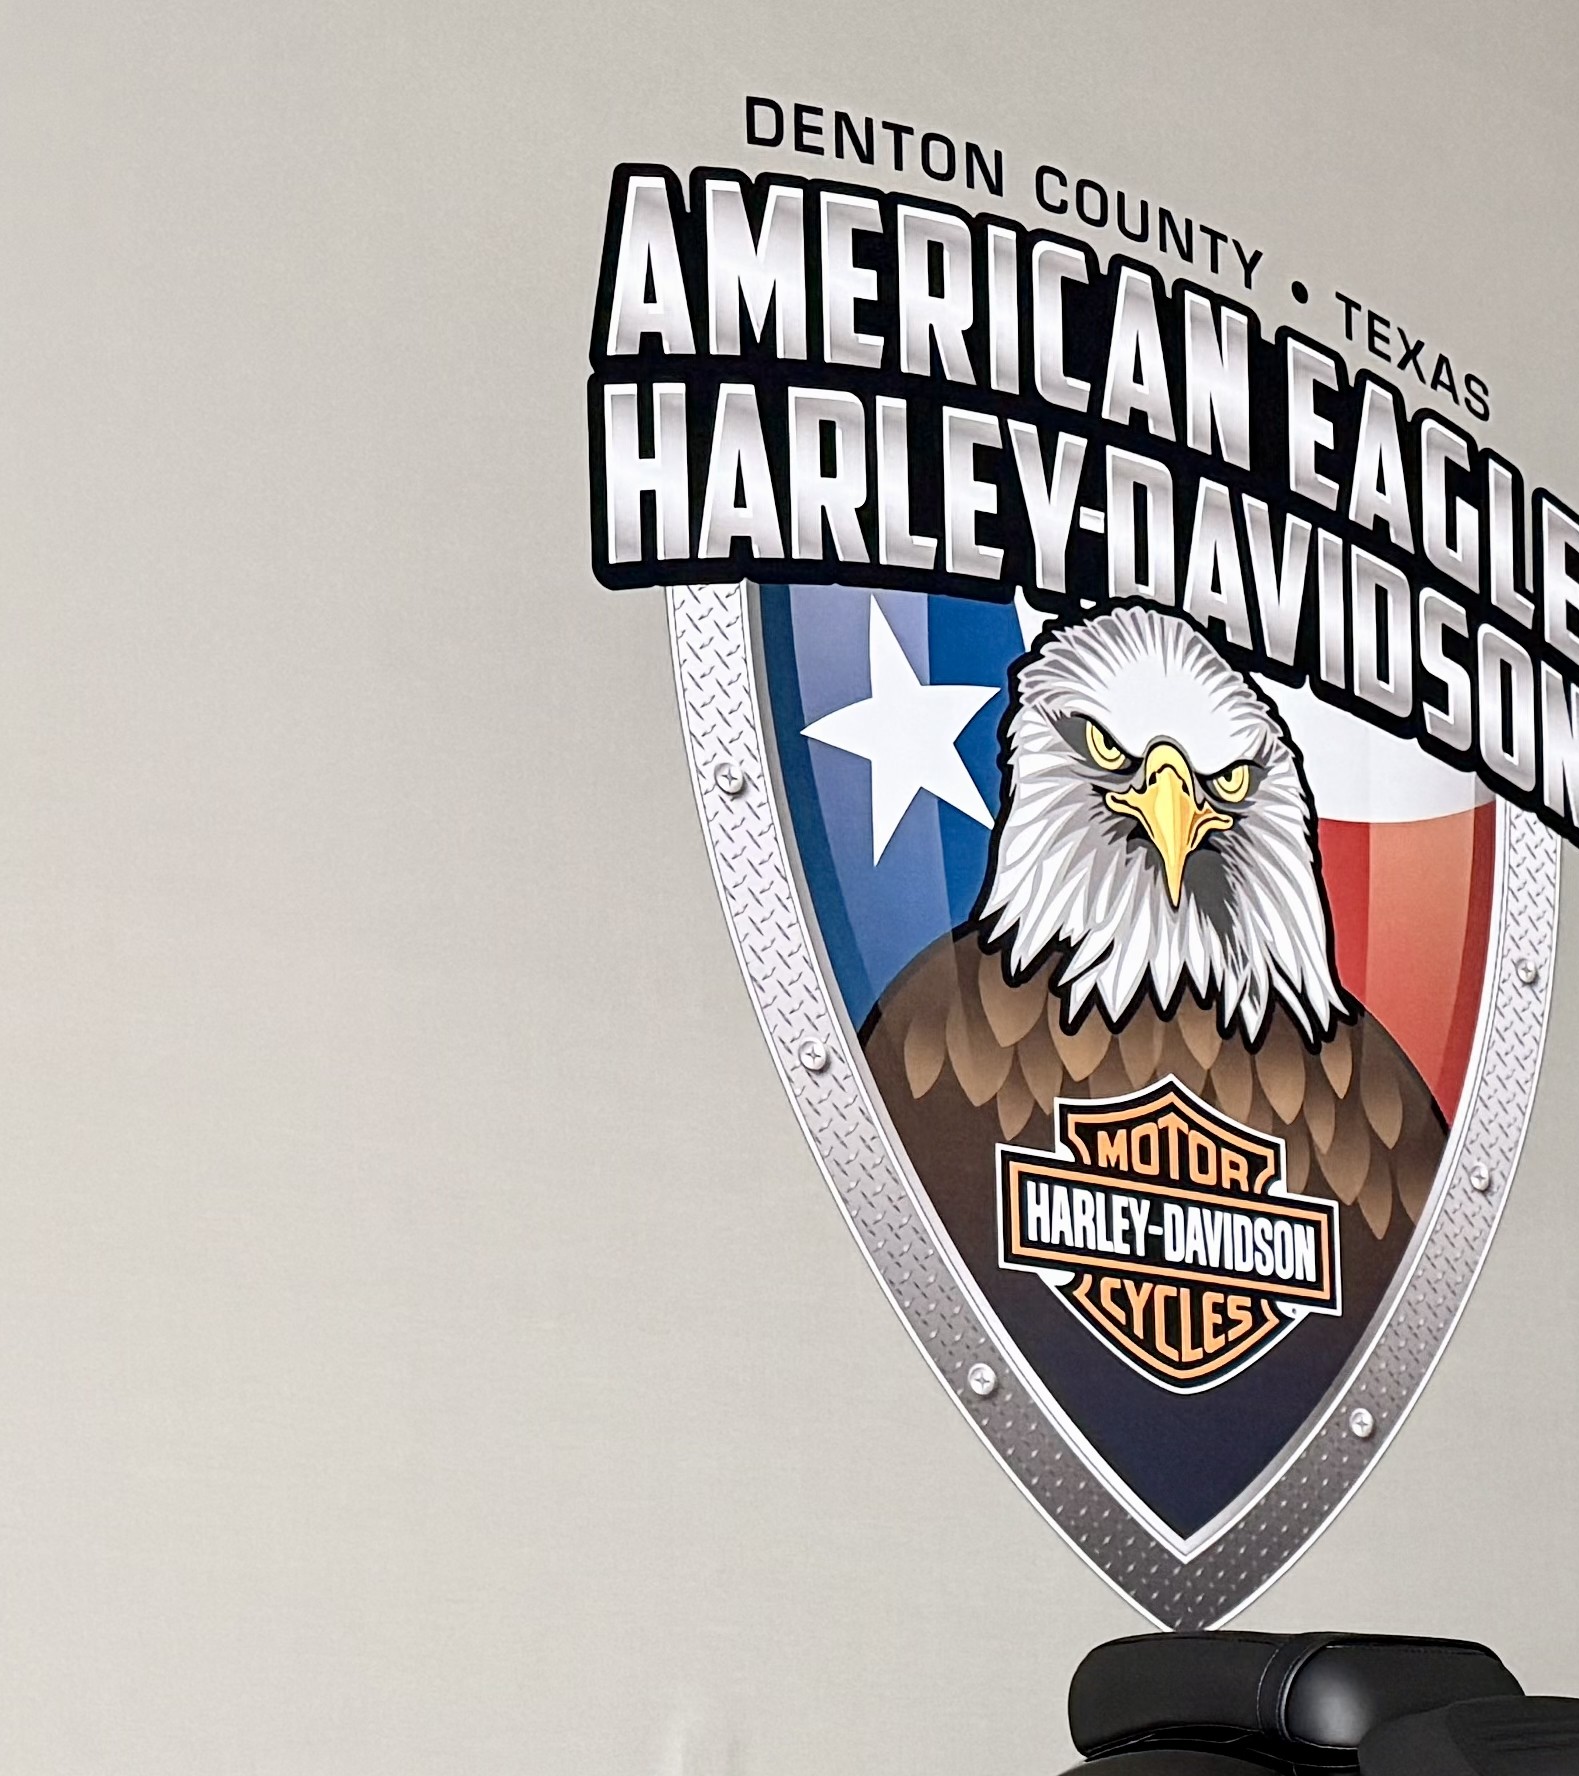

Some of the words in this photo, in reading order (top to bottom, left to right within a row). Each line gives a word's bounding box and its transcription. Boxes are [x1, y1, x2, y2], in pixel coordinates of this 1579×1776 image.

[744, 95, 1003, 197] DENTON
[1033, 163, 1264, 290] COUNTY
[1334, 290, 1491, 422] TEXAS
[604, 172, 1251, 469] AMERICAN
[1097, 1112, 1249, 1192] MOTOR
[1025, 1180, 1317, 1283] HARLEY-DAVIDSON
[1099, 1276, 1253, 1363] CYCLES
